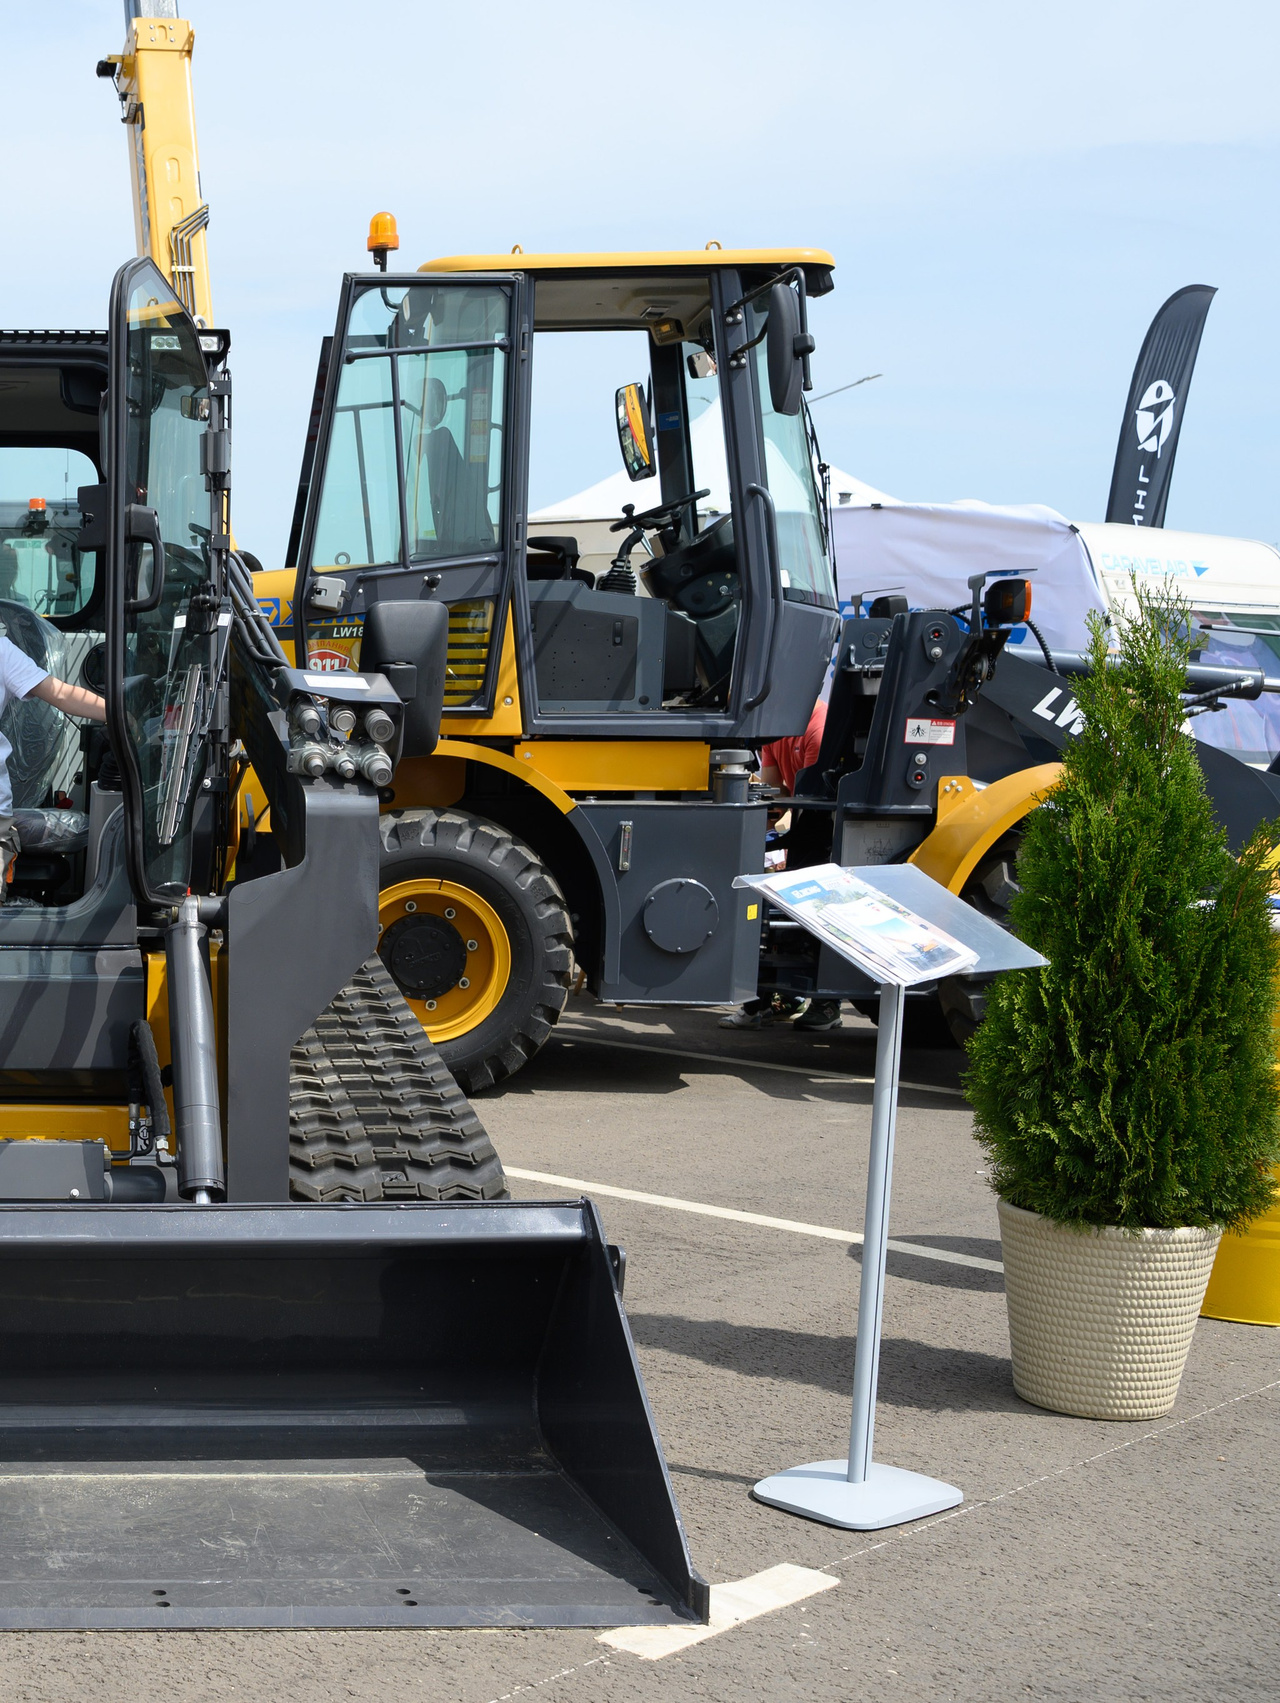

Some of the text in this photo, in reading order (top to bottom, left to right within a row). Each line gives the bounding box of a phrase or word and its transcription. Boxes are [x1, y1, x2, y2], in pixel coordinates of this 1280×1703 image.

[1101, 552, 1189, 577] CARAVELAIR
[308, 640, 350, 653] ОМПАНИЯ
[309, 658, 340, 672] 911
